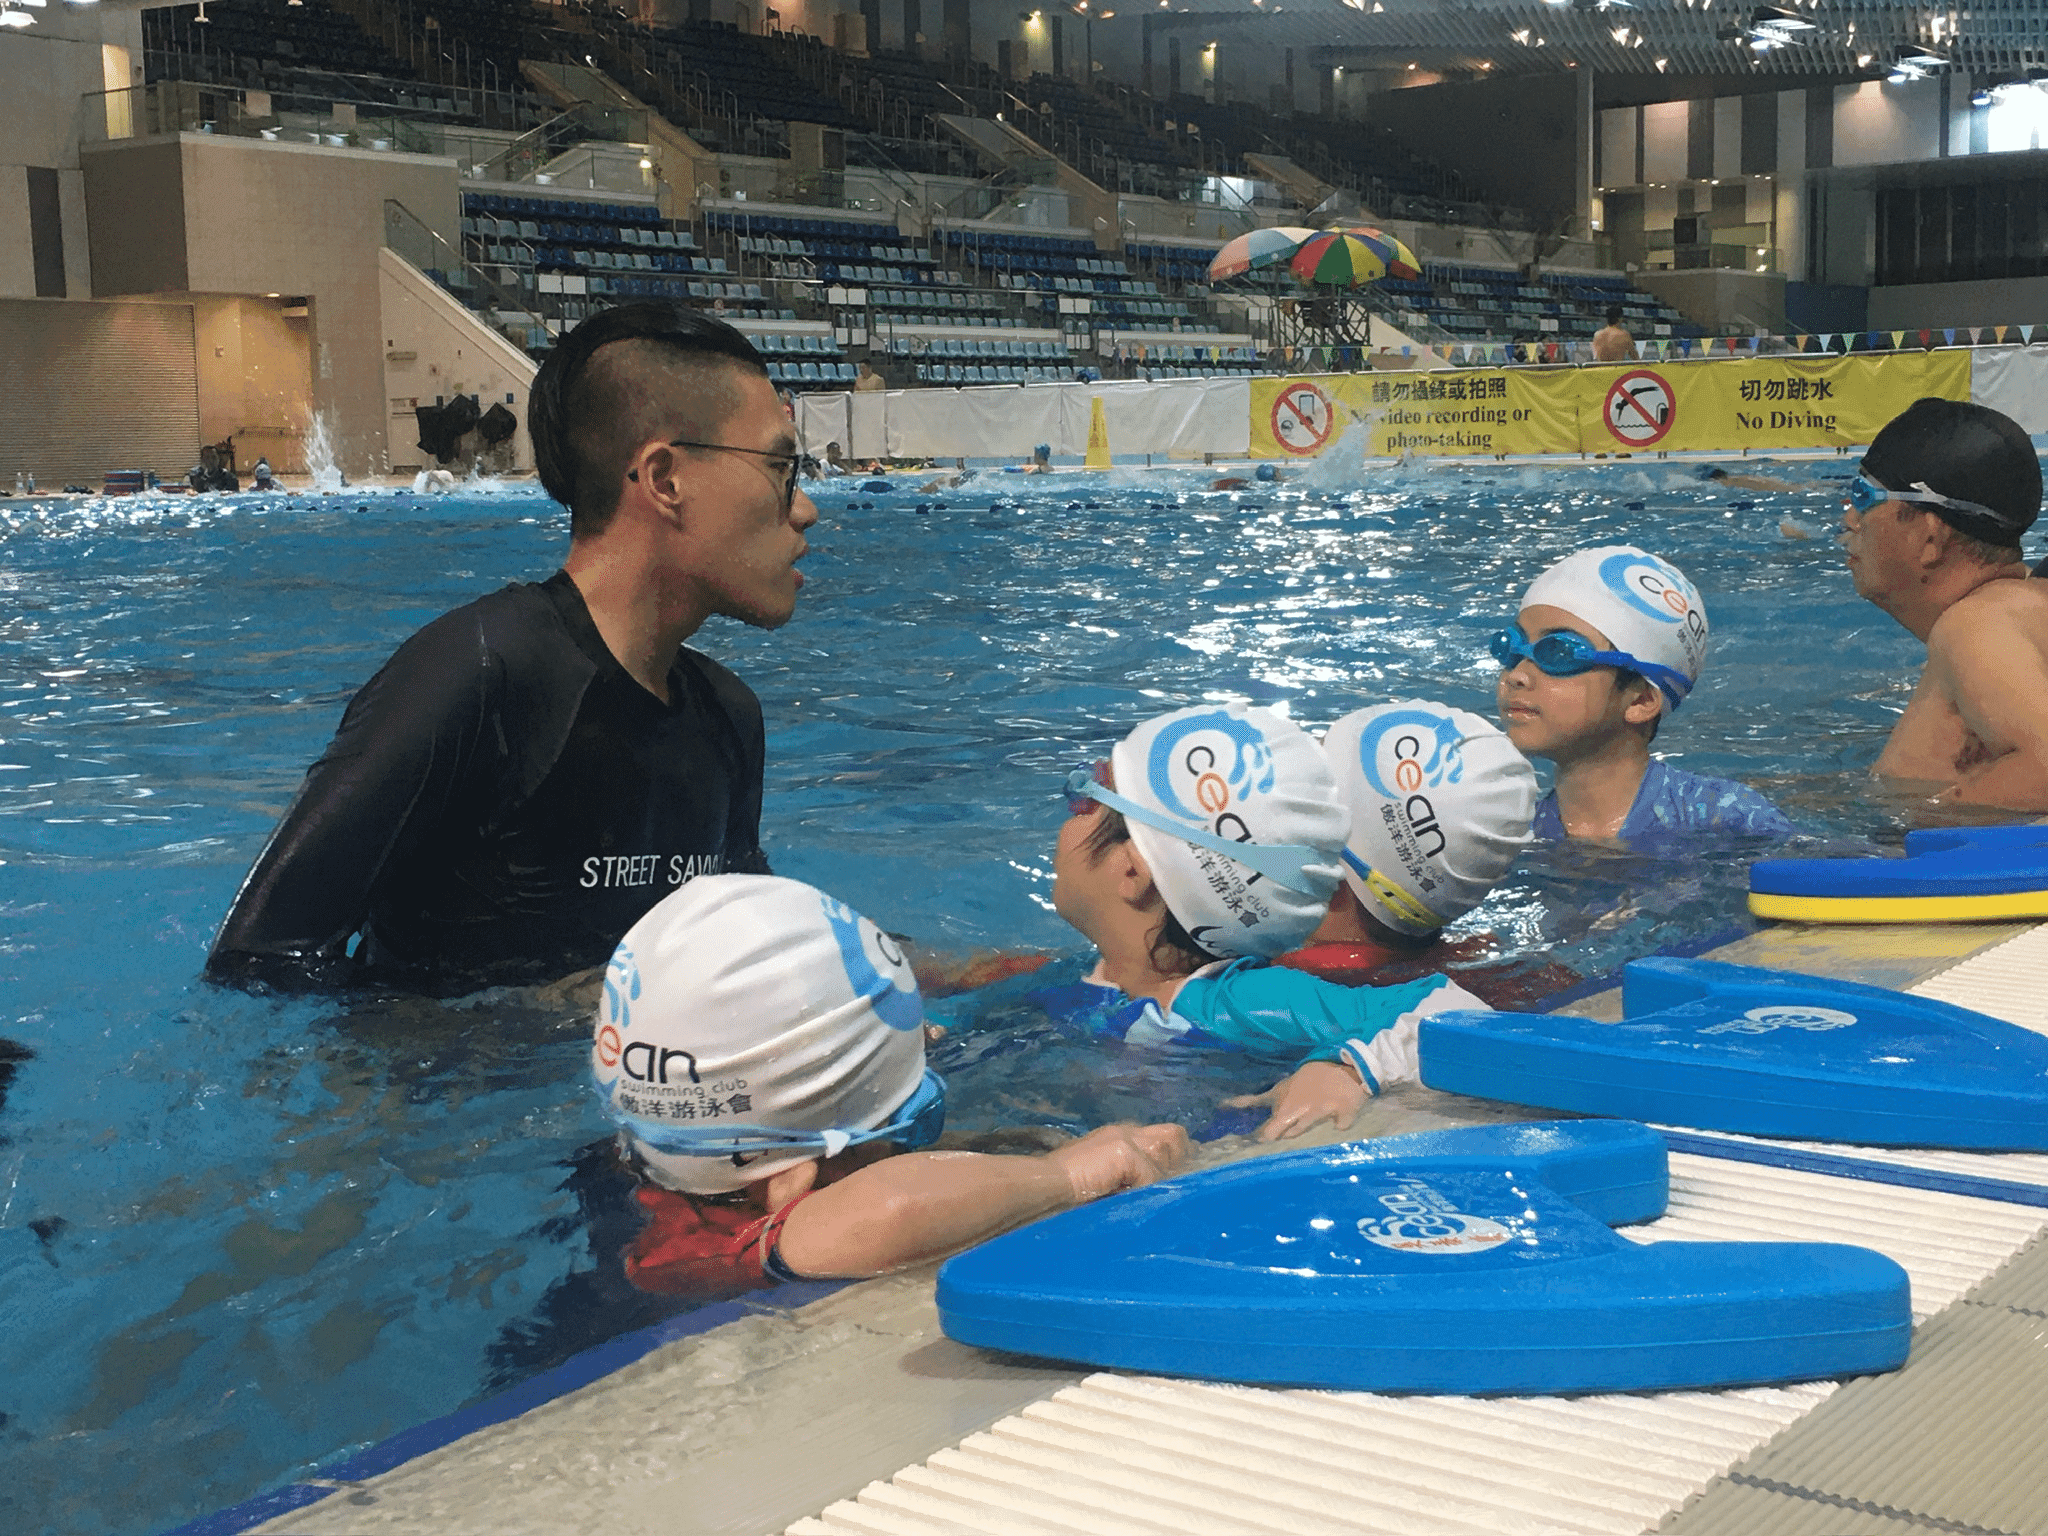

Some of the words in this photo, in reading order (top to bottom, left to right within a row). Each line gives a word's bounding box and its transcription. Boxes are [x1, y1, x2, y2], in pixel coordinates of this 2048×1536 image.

[1372, 377, 1507, 403] 請勿攝錄或拍照
[1739, 377, 1834, 401] 切勿跳水
[1379, 406, 1422, 425] ideo
[1426, 405, 1507, 426] recording
[1512, 407, 1532, 422] or
[1736, 411, 1763, 430] No
[1770, 410, 1836, 433] Diving
[1387, 430, 1493, 452] photo-taking
[1394, 801, 1427, 865] swimming
[579, 855, 661, 888] STREET
[1247, 894, 1270, 918] club
[620, 1078, 706, 1099] swimming
[711, 1077, 749, 1093] club
